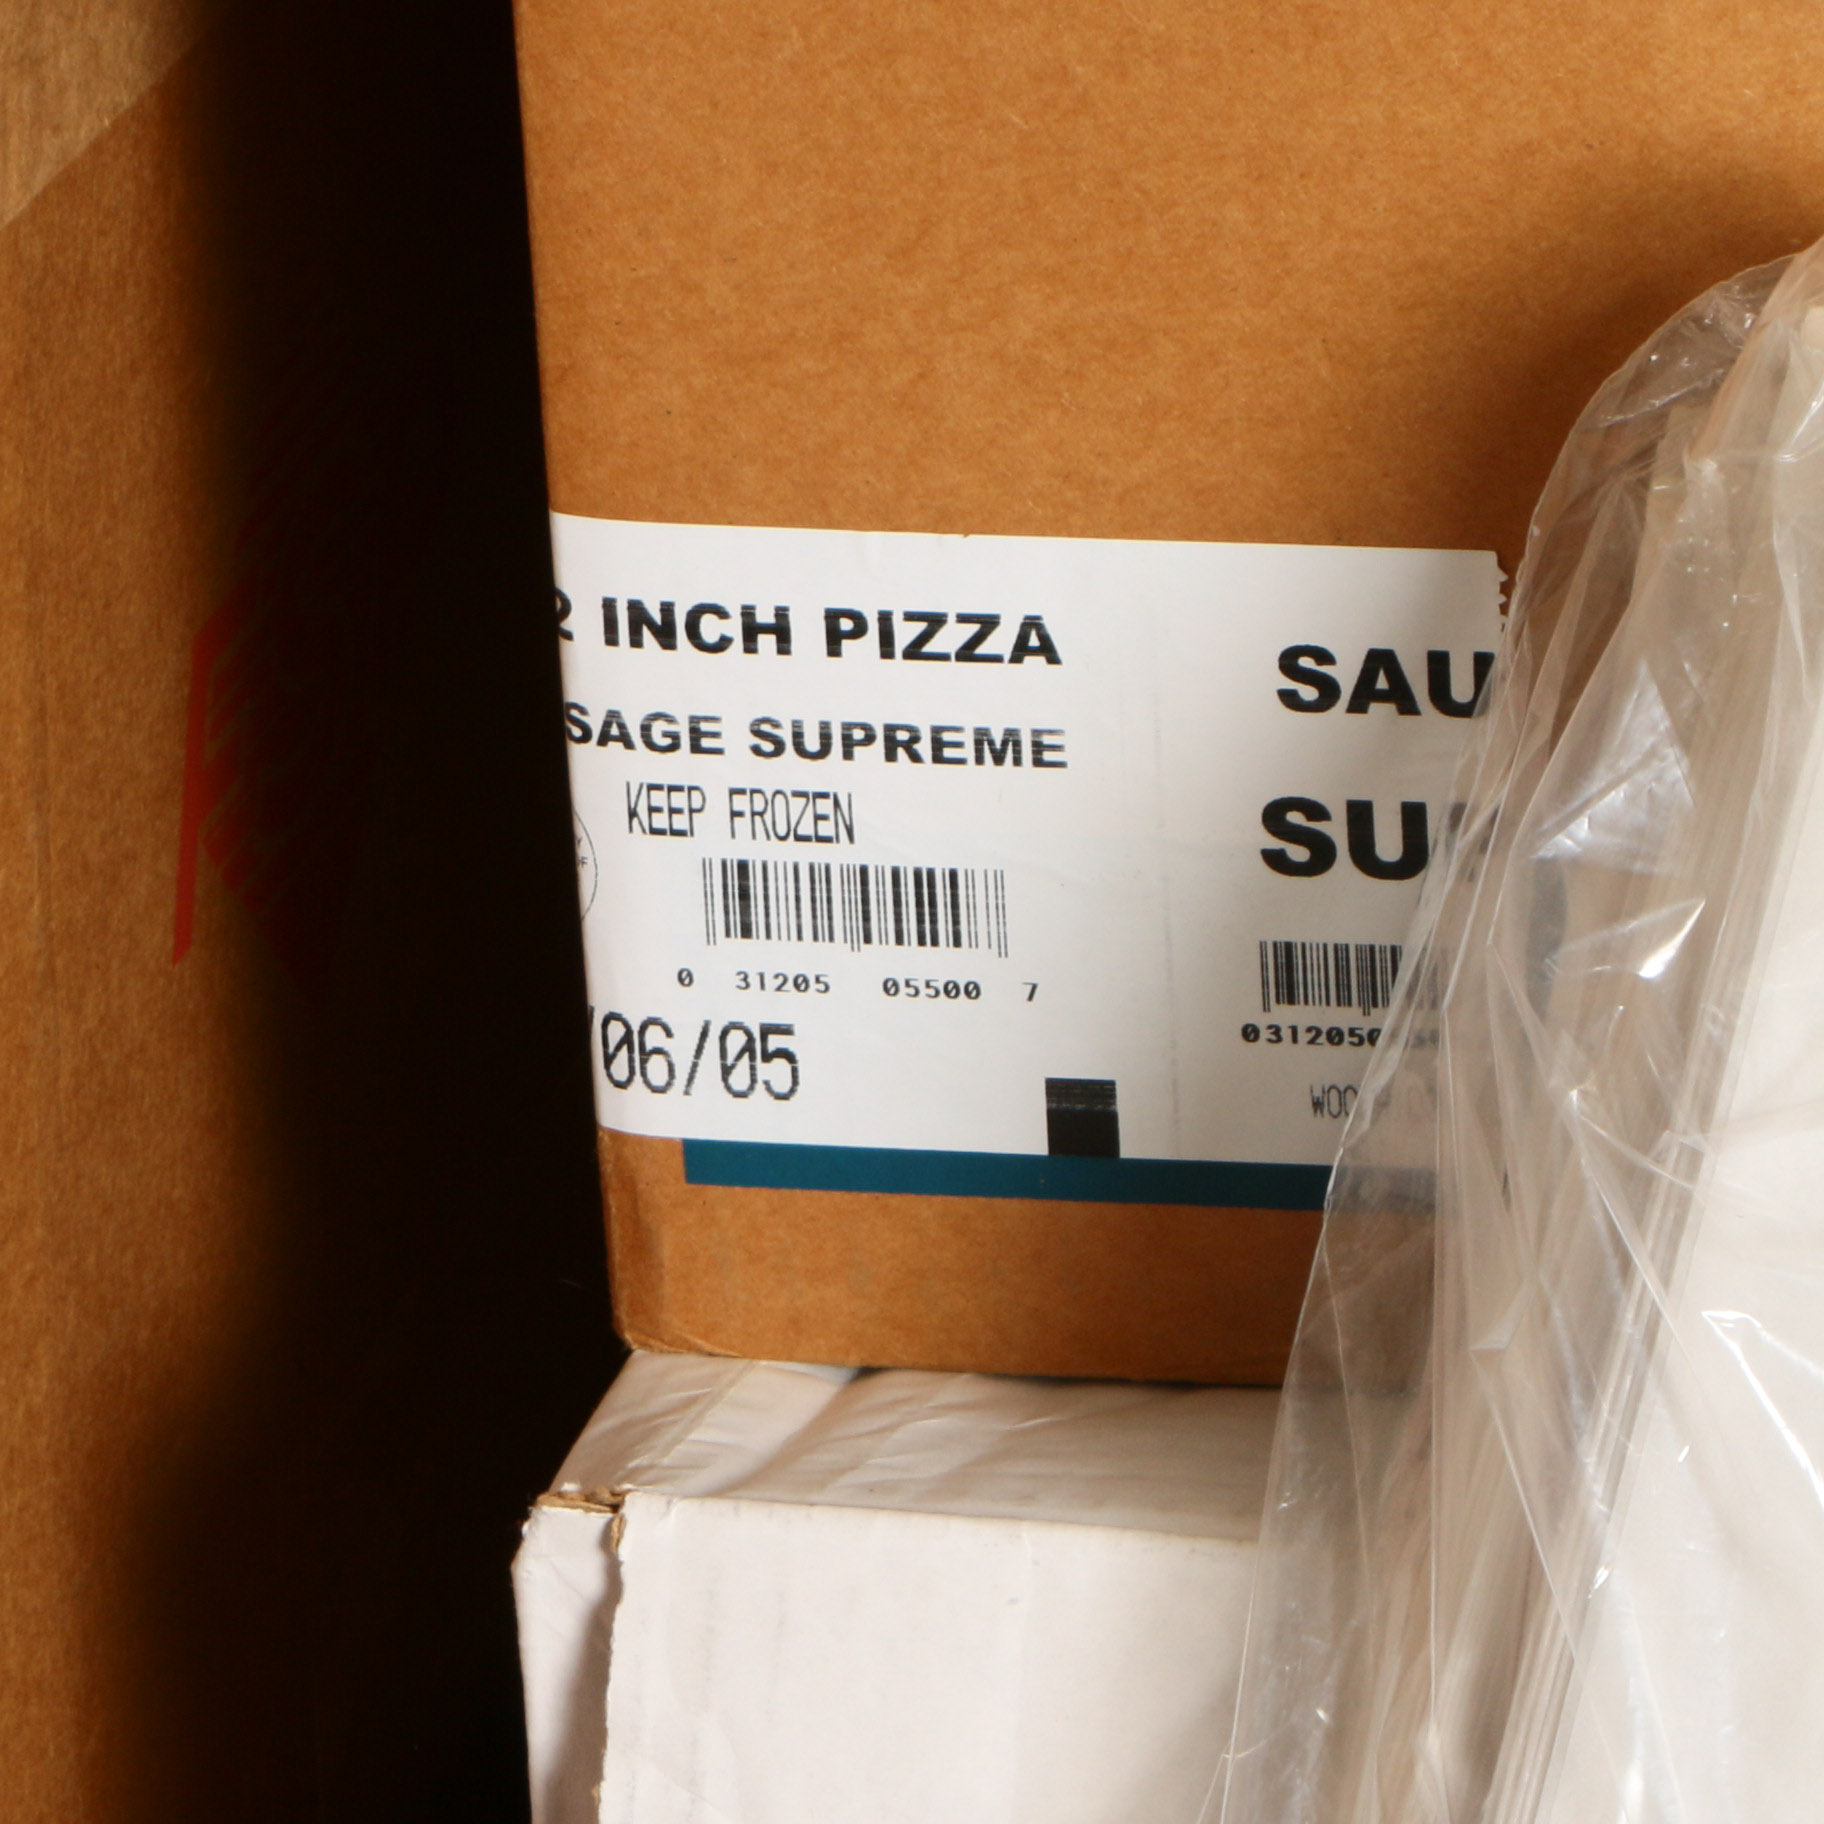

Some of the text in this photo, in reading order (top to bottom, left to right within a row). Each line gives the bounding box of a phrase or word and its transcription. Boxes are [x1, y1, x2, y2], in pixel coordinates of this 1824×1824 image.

[601, 596, 792, 656] INCH
[824, 607, 1062, 667] PIZZA
[564, 701, 1069, 770] SAGE SUPREME
[626, 781, 855, 845] KEEP FROZEN
[677, 968, 1040, 1003] 0 31205 05500 7
